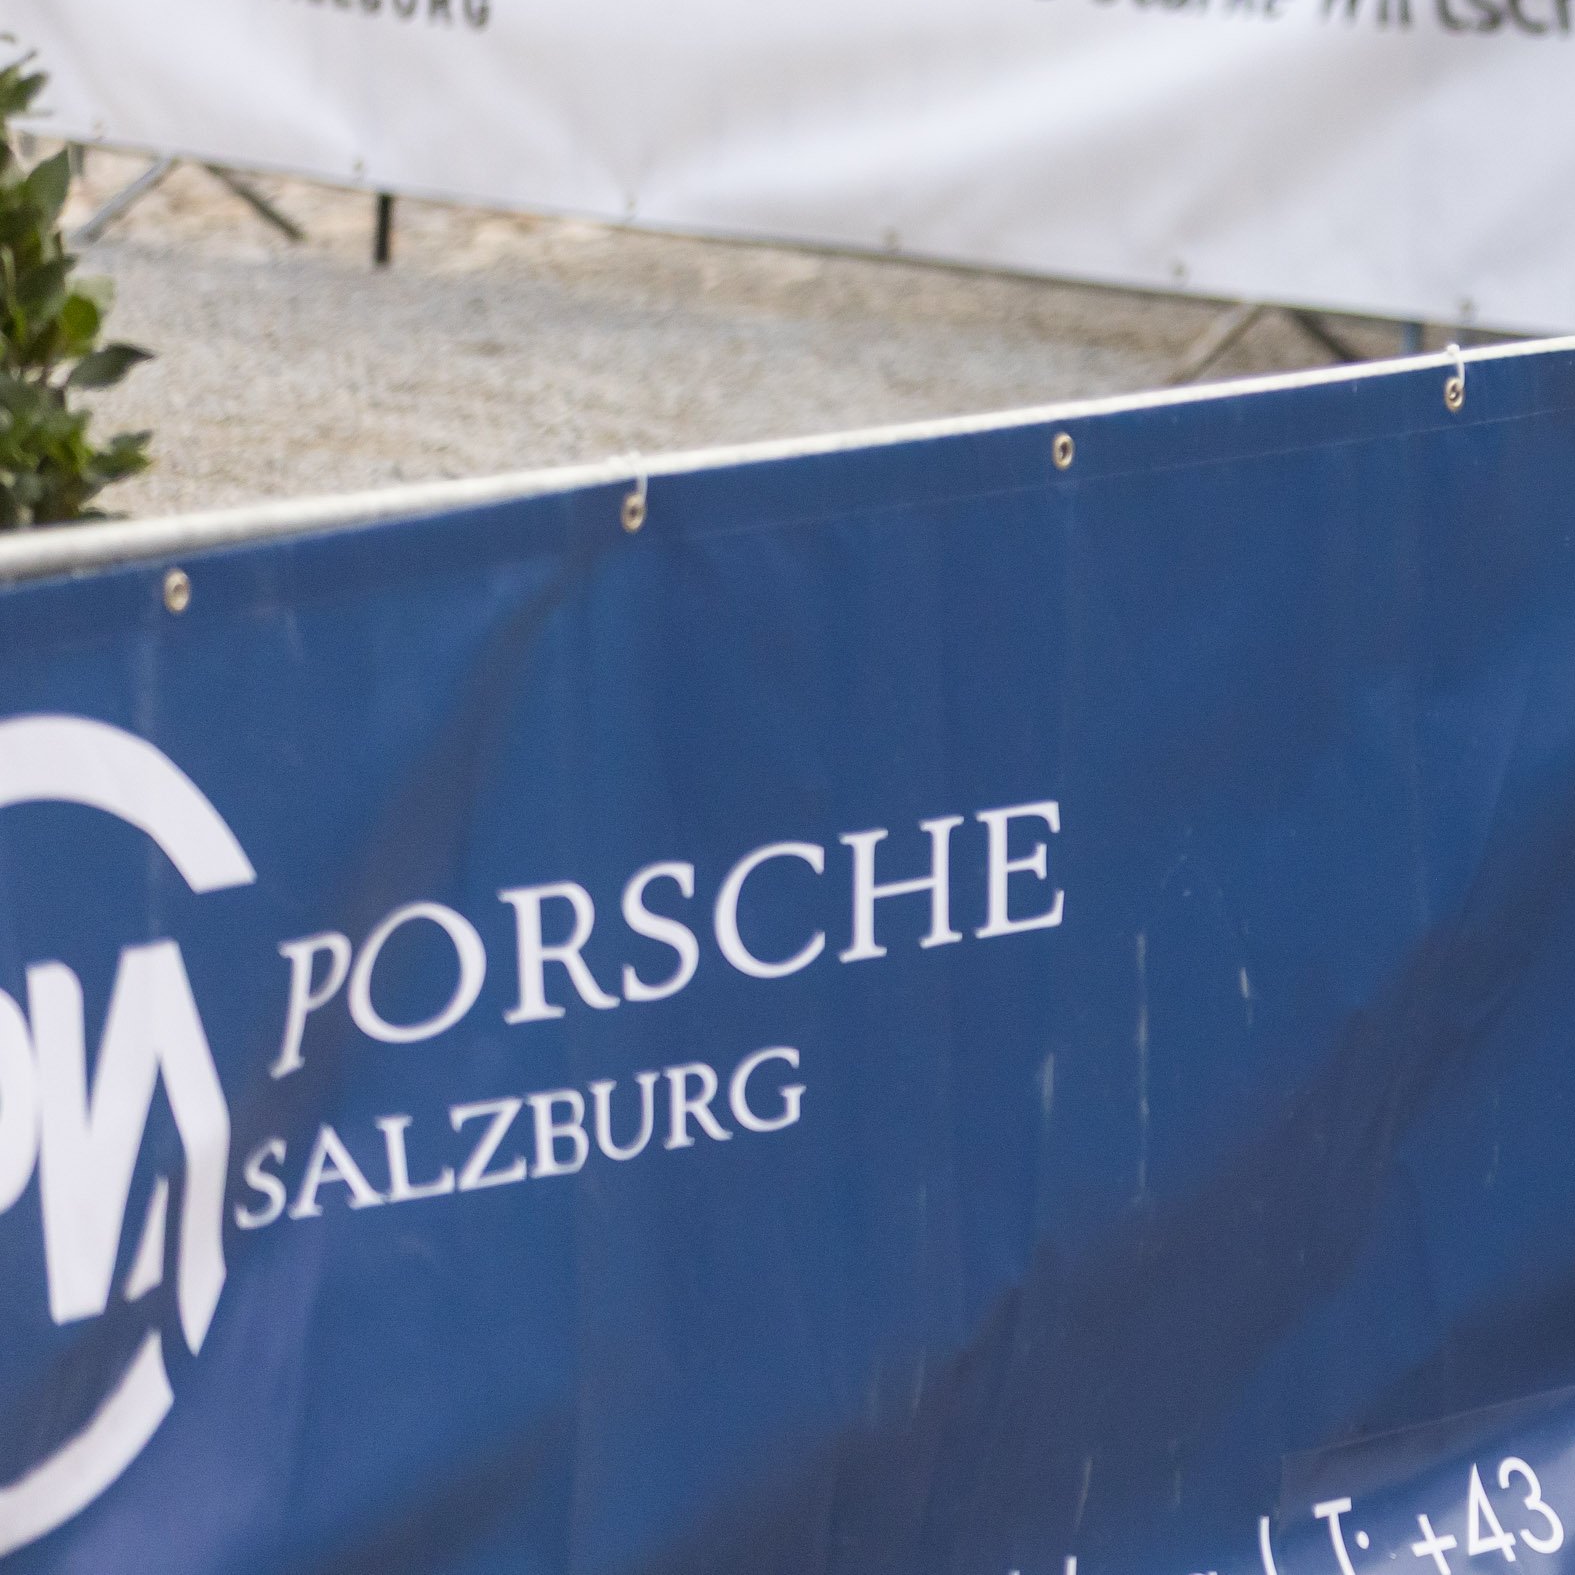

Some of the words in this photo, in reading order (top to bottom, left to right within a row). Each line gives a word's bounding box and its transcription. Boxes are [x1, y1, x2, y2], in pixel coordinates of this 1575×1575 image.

[271, 800, 1066, 1079] PORSCHE
[233, 1046, 806, 1229] SALZBURG
[1410, 1455, 1566, 1575] +43
